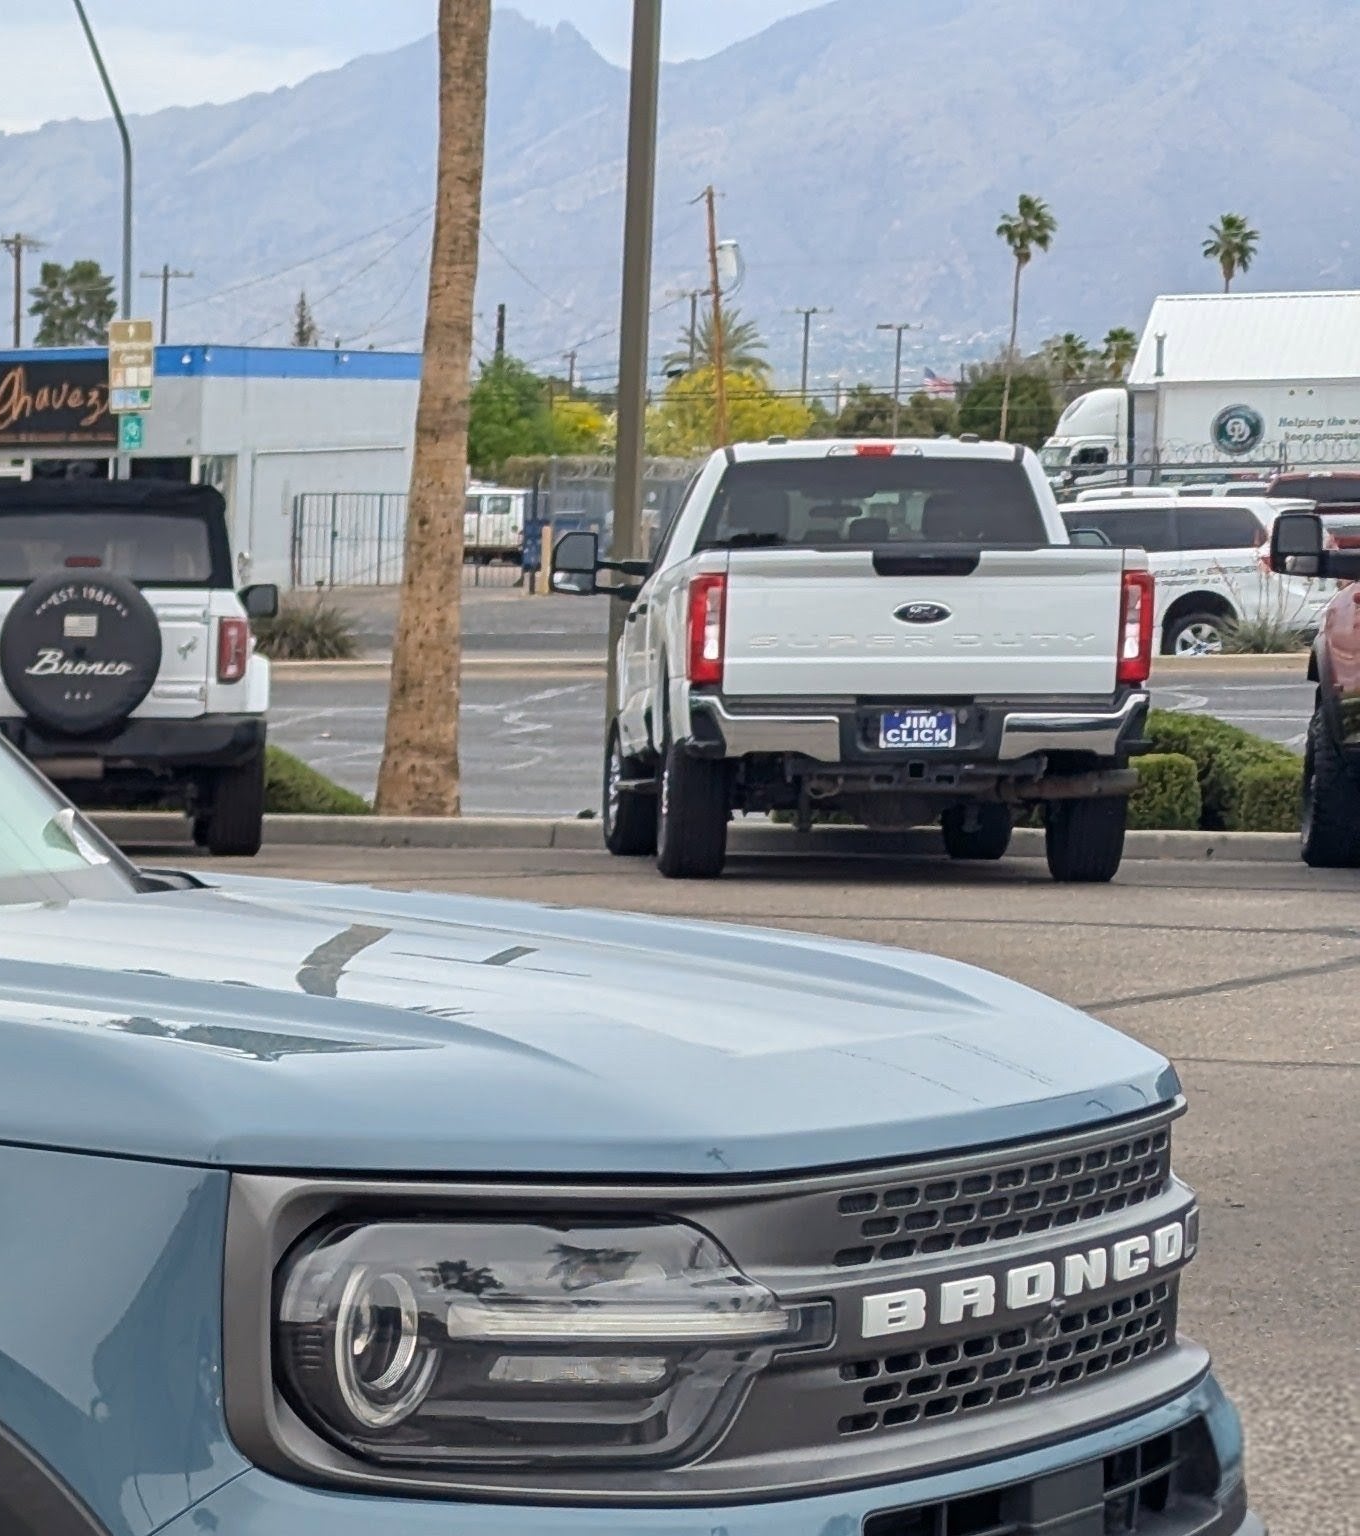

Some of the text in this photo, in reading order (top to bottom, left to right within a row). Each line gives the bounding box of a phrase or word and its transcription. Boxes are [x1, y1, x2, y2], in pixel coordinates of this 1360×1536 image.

[749, 632, 1097, 649] SUPER DUTY
[25, 648, 133, 676] Bronco
[900, 716, 937, 729] JIM
[886, 729, 949, 742] CLICK
[861, 1221, 1184, 1339] BRONCO
